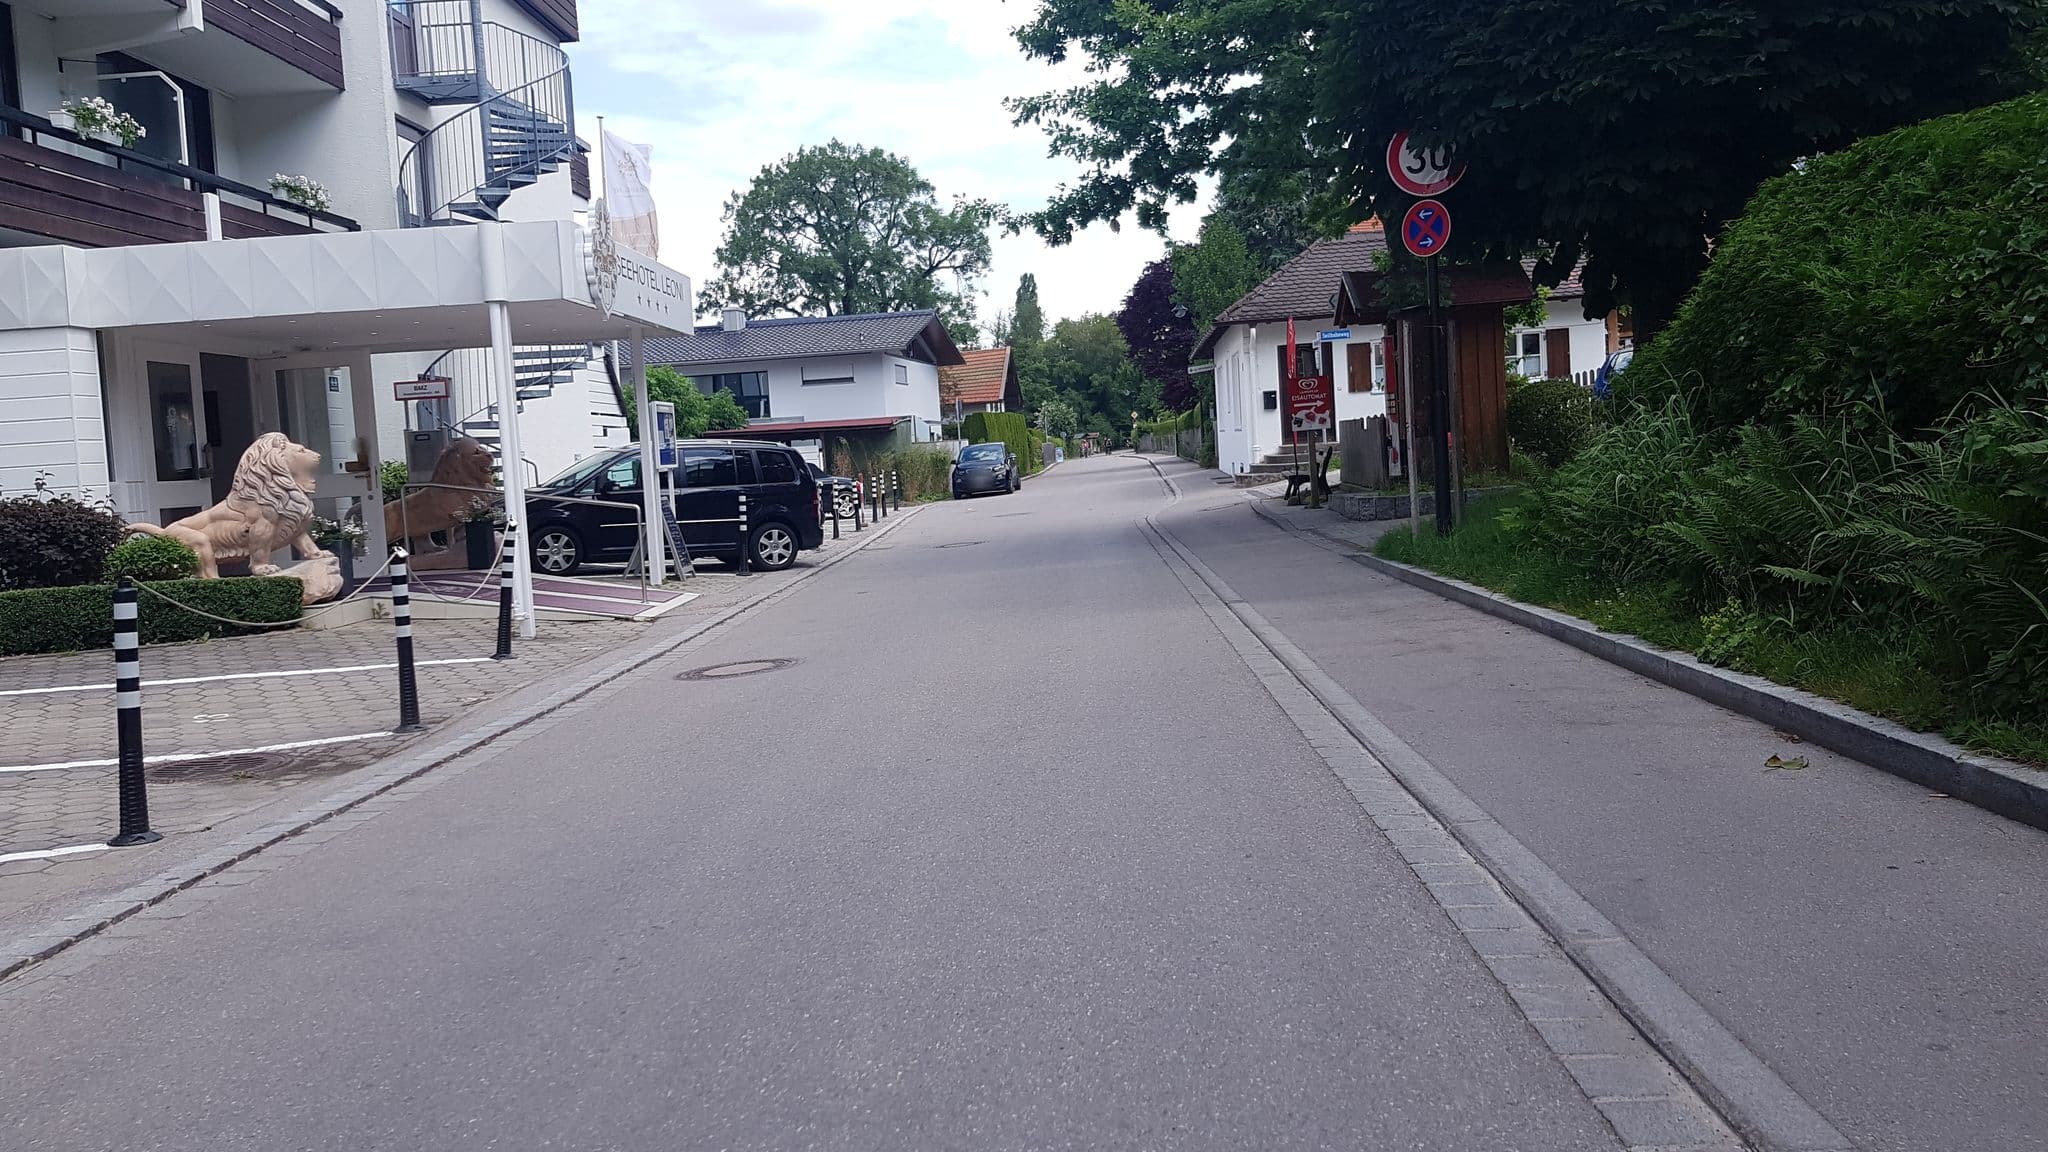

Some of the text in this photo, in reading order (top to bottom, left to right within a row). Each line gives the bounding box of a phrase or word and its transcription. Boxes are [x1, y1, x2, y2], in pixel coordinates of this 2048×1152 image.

[616, 254, 685, 301] SEEHOTEL LEONI
[1291, 393, 1327, 401] EISAUTOMAT
